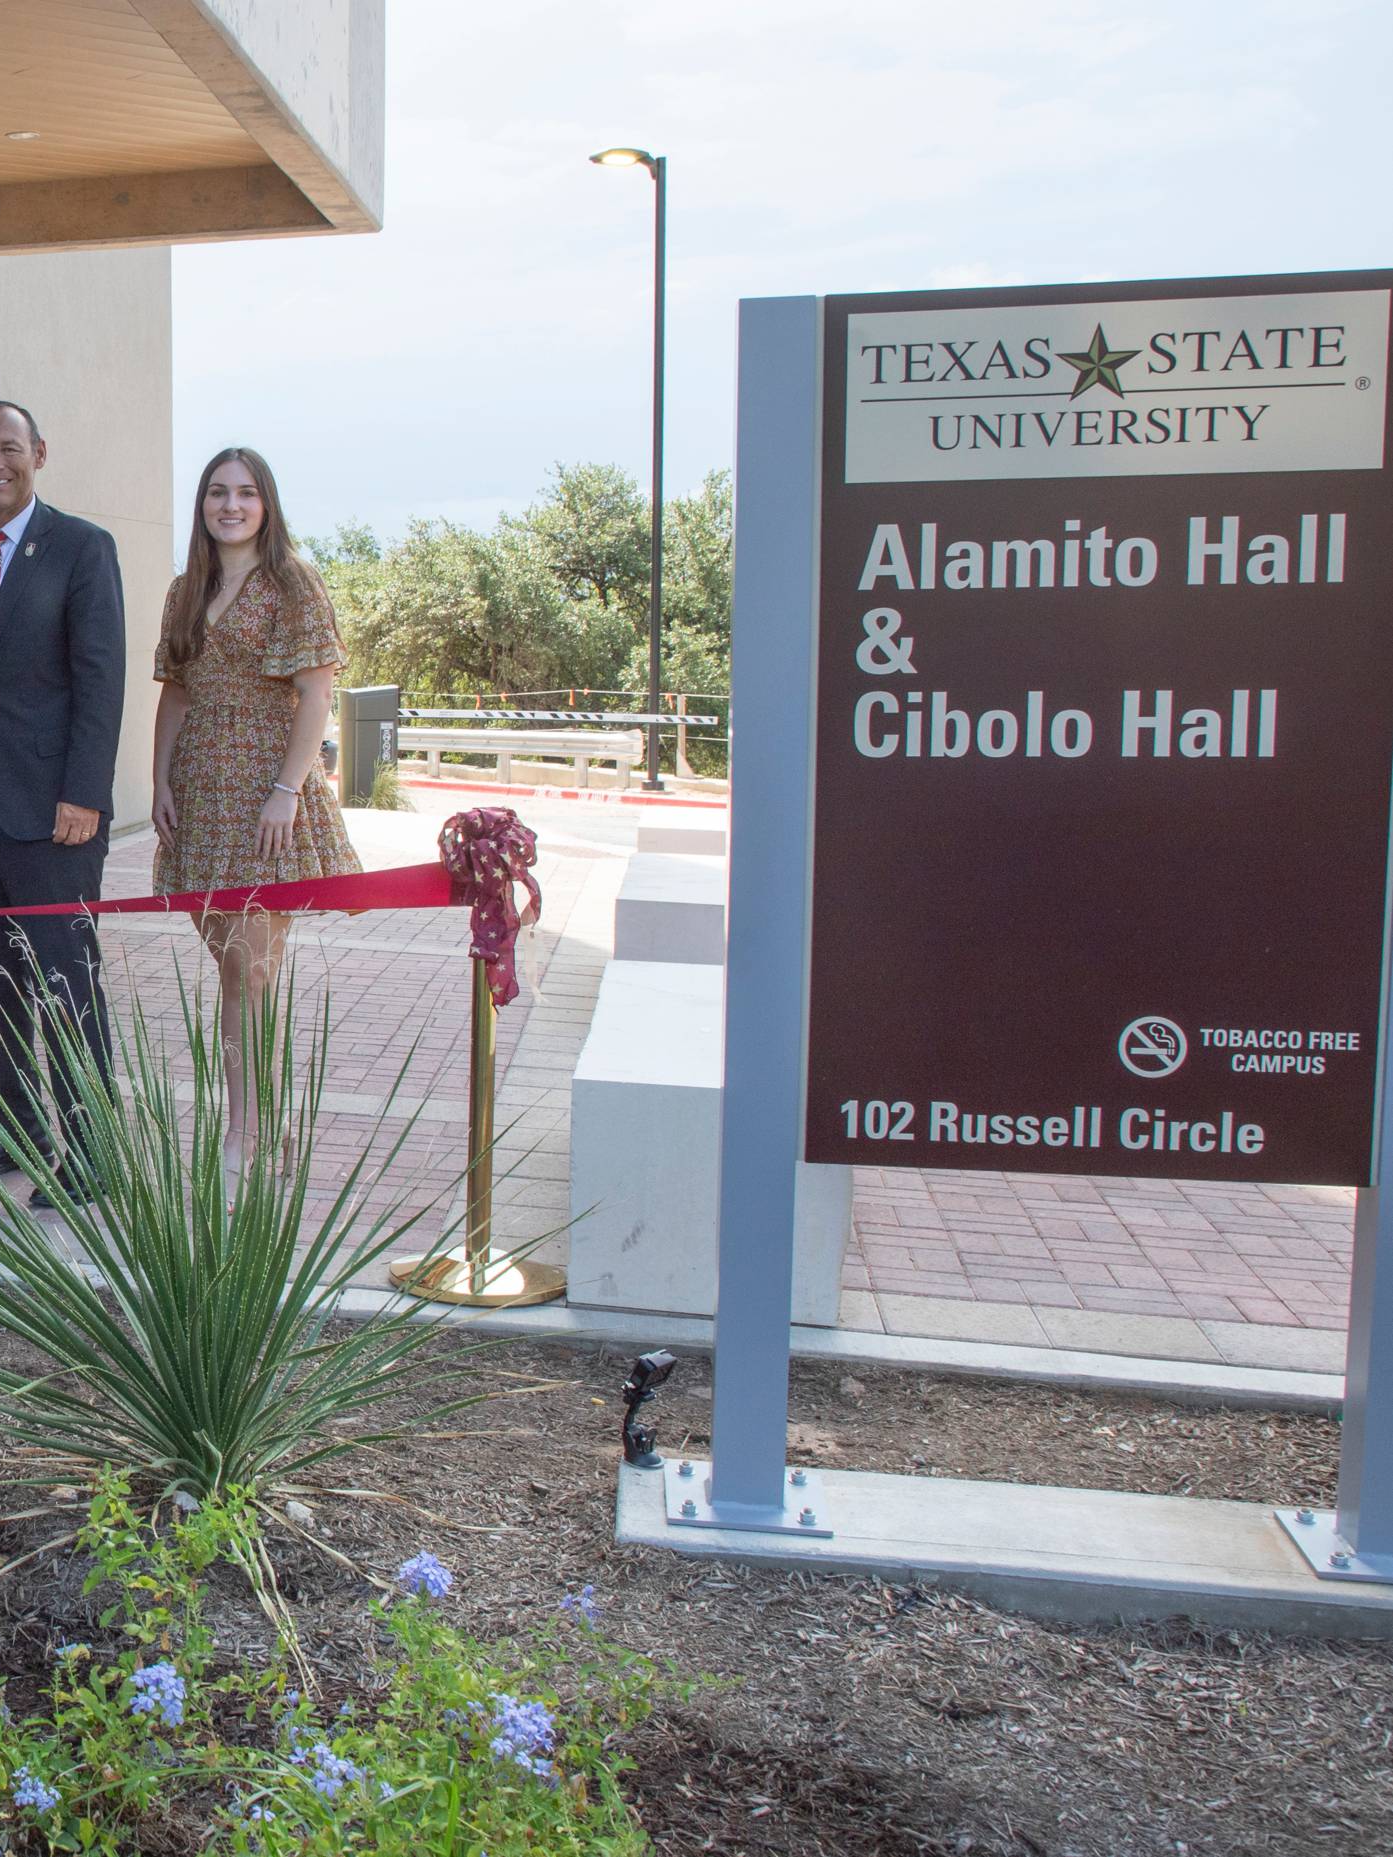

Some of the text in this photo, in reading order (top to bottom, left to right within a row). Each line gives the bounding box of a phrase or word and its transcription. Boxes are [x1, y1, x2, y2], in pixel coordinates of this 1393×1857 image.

[861, 338, 1050, 384] TEXAS
[1148, 326, 1347, 374] STATE
[929, 404, 1270, 451] UNIVERSITY
[857, 513, 1347, 591] Alamito Hall
[855, 607, 918, 675] &
[854, 689, 1278, 758] Cibolo Hall
[1200, 1028, 1361, 1051] TOBACCO FREE
[1231, 1053, 1326, 1075] CAMPUS
[840, 1099, 1265, 1154] 102 Russell Circle
